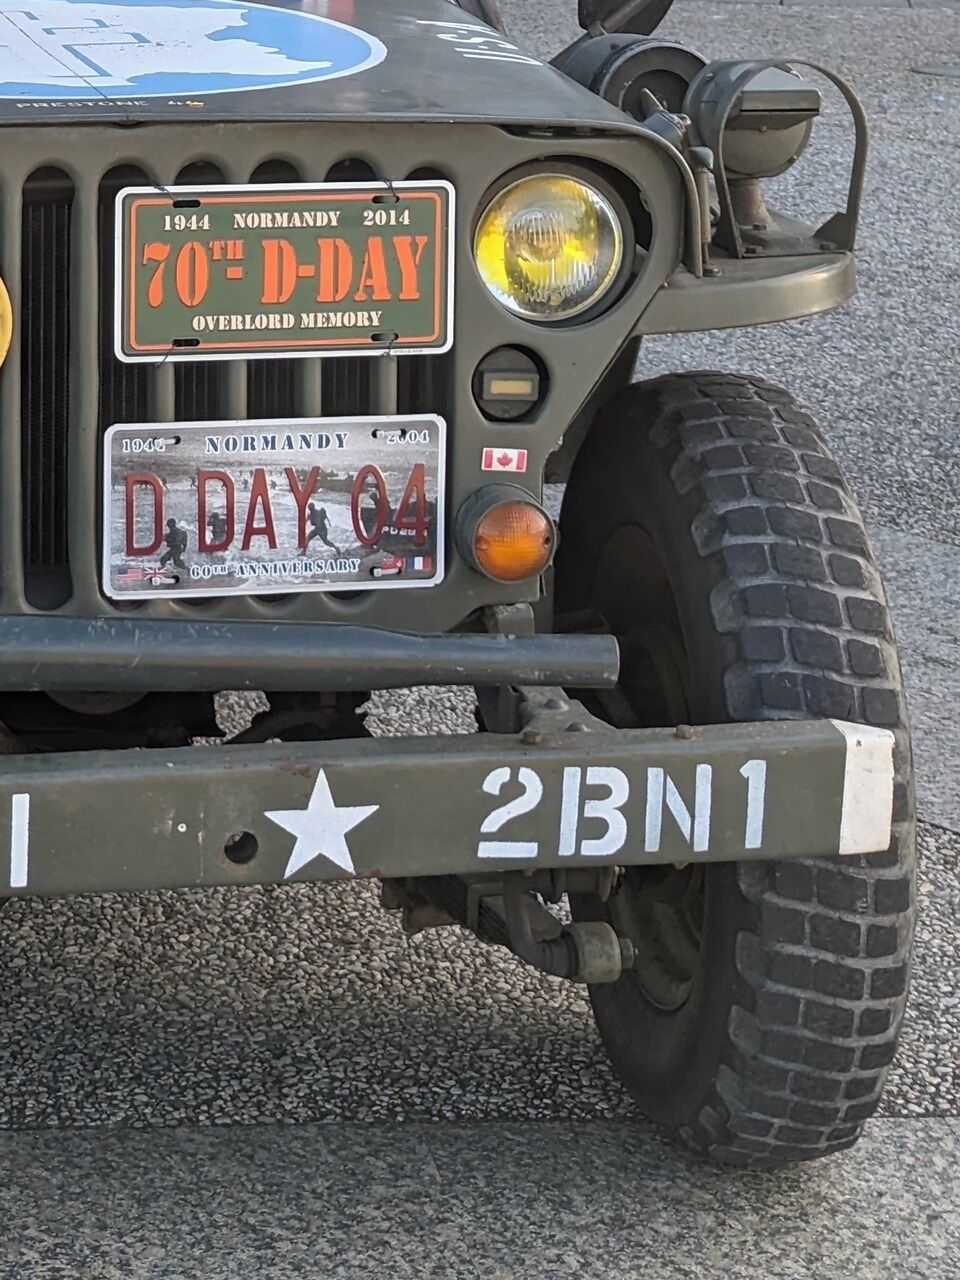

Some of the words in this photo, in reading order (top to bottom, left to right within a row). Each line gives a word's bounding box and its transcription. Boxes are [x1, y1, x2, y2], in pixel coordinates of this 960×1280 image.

[16, 100, 149, 108] PRESTONE
[162, 213, 211, 231] 1944
[232, 210, 342, 230] NORMANDY
[362, 209, 411, 226] 2014
[260, 235, 429, 304] D-DAY
[191, 313, 296, 332] OVERLORD
[299, 310, 383, 329] MEMORY
[204, 432, 349, 455] NORMANDY
[124, 472, 164, 557] D
[197, 465, 322, 553] DAY
[350, 462, 431, 547] 04
[235, 559, 362, 578] ANNIVERSARY
